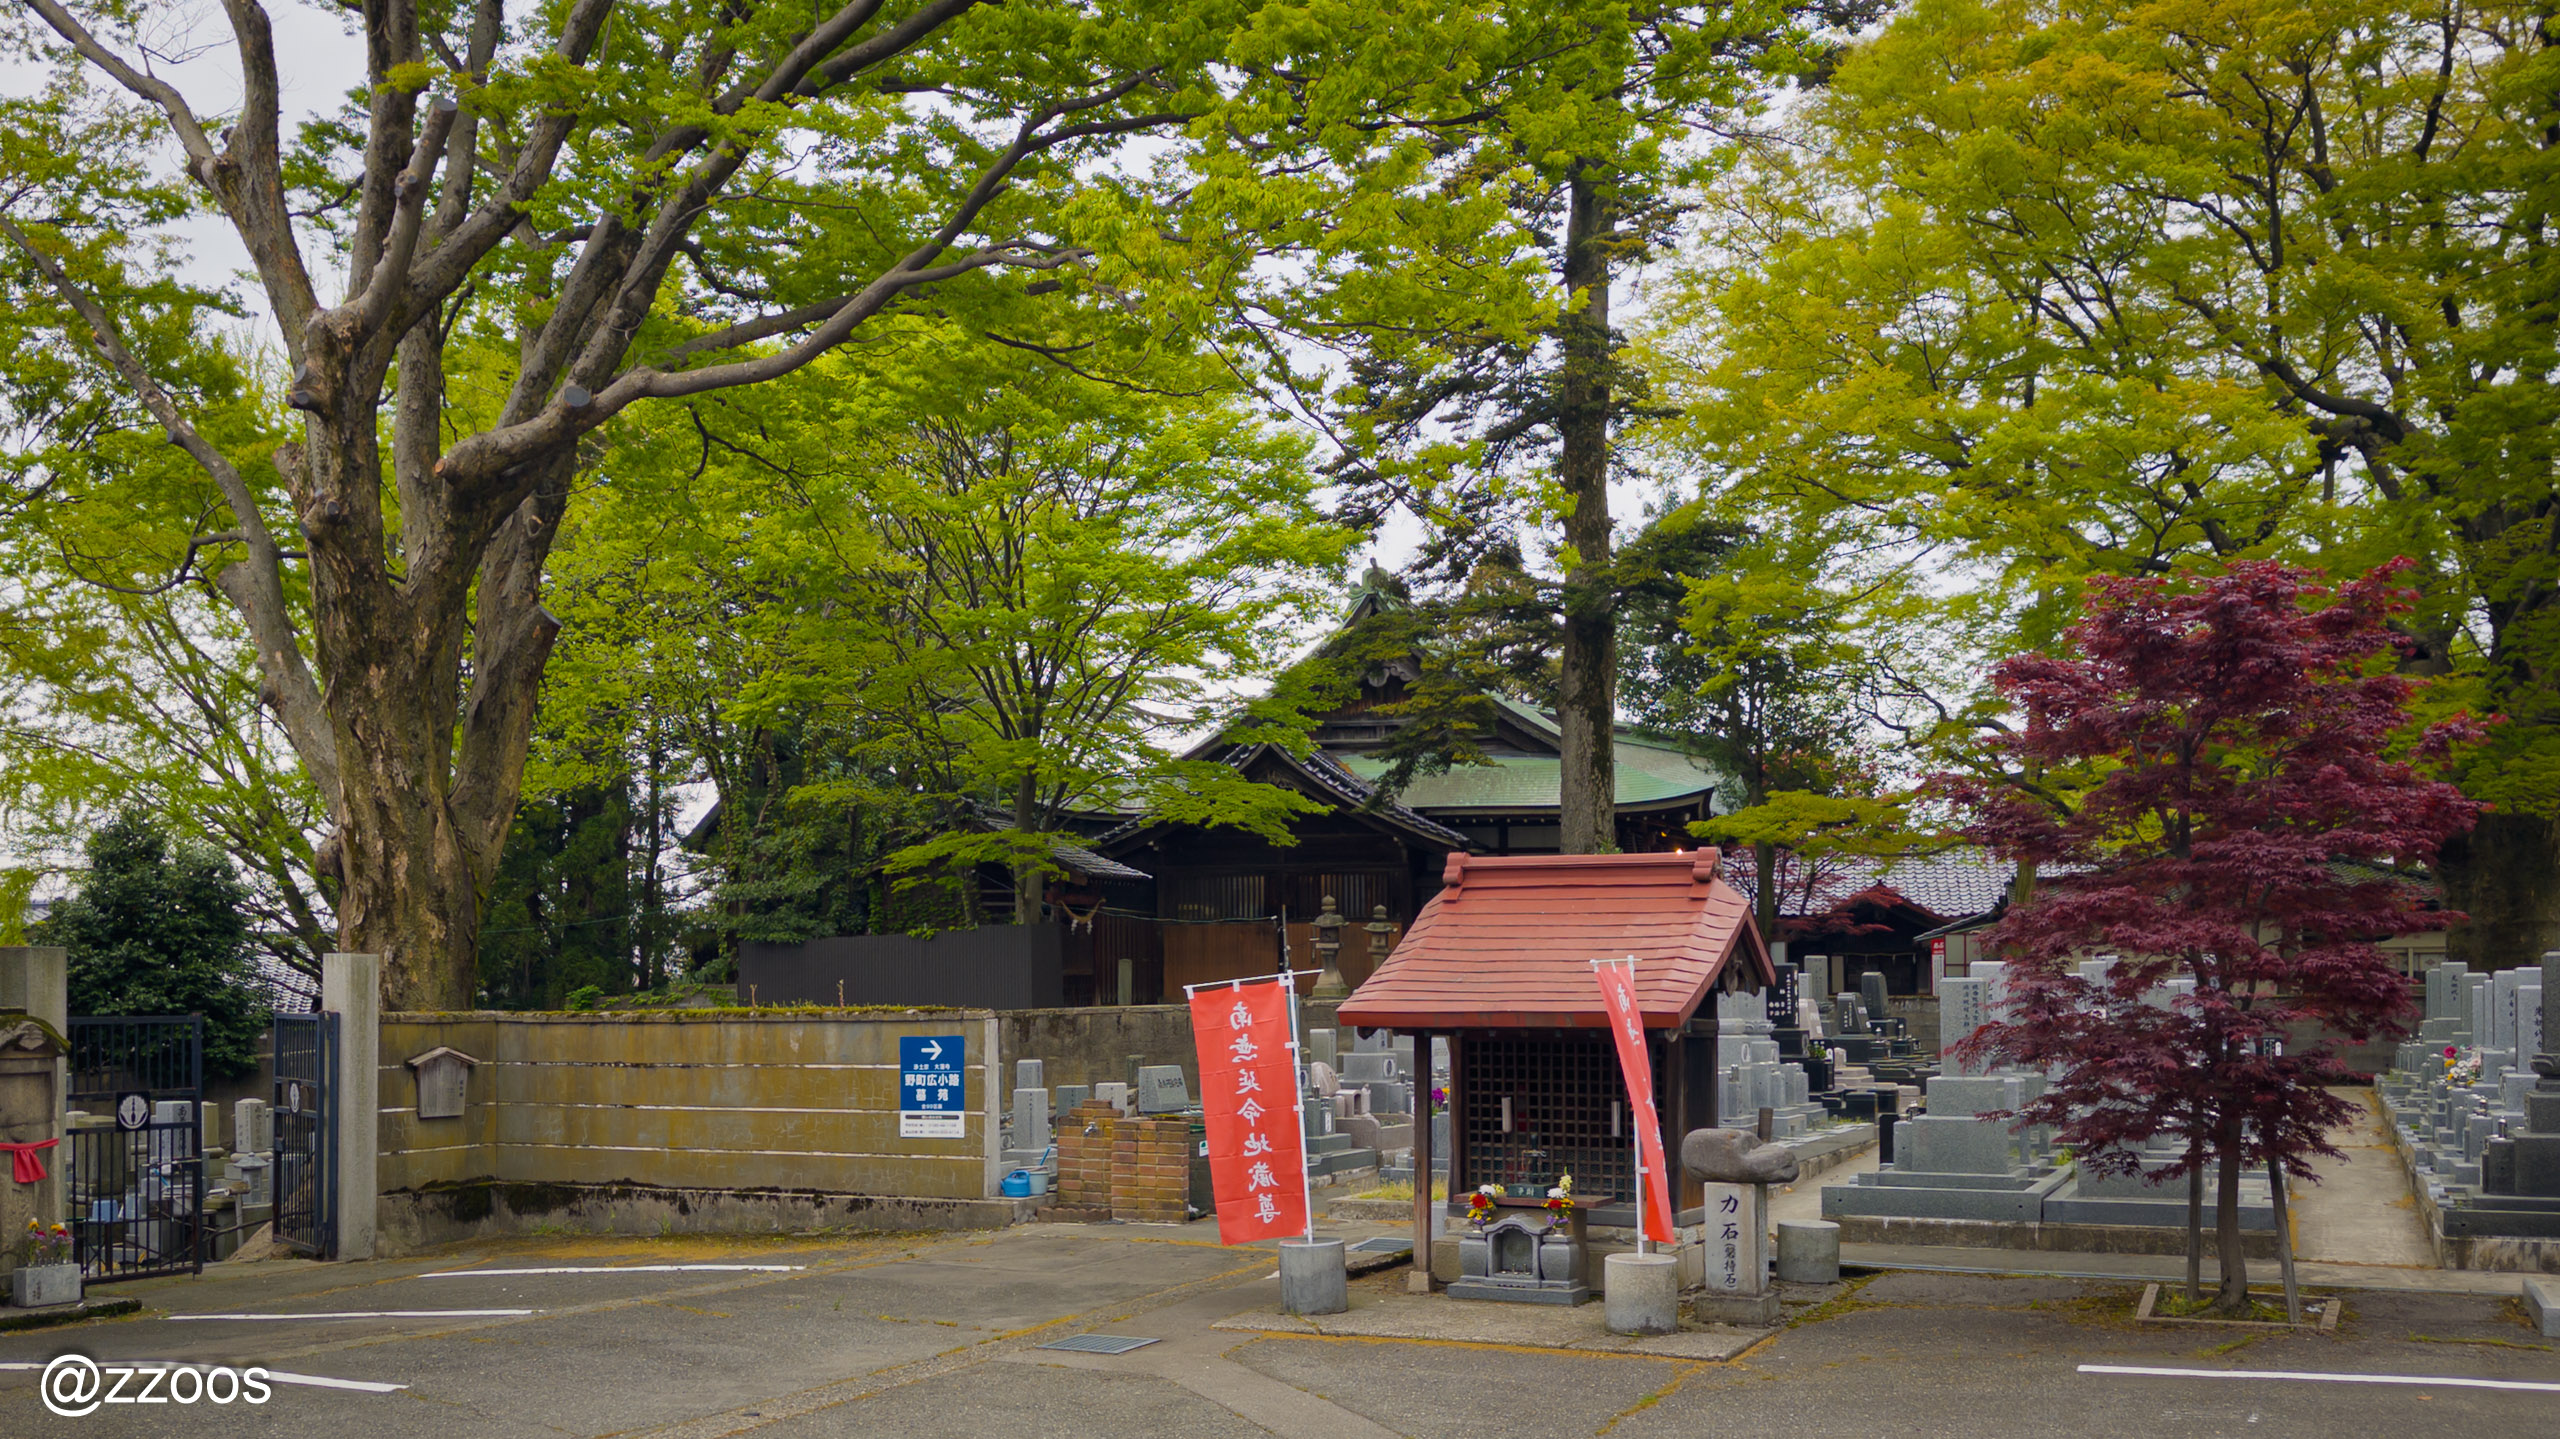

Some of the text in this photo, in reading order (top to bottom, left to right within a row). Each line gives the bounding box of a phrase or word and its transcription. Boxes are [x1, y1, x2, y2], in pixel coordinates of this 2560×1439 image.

[905, 1073, 959, 1086] 野町広小路
